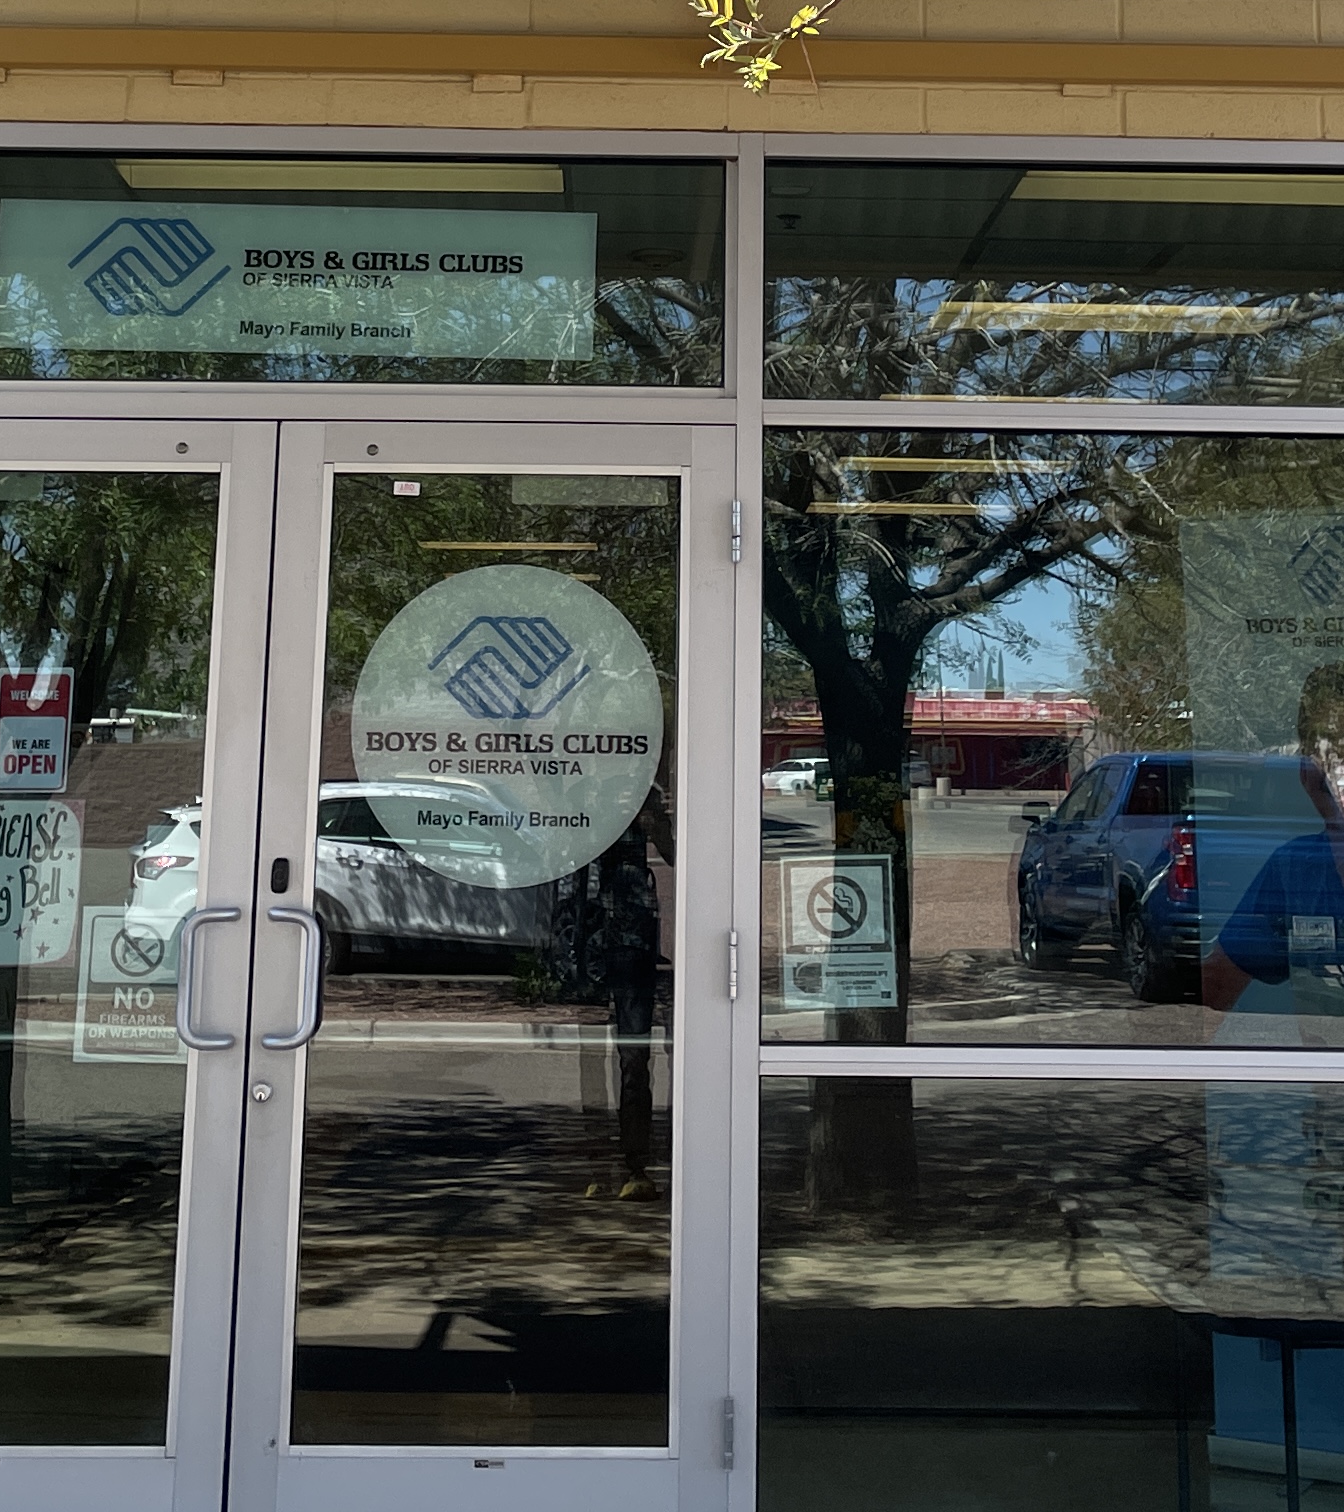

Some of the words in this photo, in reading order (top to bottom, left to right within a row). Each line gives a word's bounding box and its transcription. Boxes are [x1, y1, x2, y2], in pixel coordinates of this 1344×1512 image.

[243, 249, 315, 270] BOYS
[323, 250, 346, 270] &
[352, 252, 430, 272] GIRLS
[438, 254, 524, 274] CLUBS
[242, 272, 266, 287] OF
[272, 273, 338, 289] SIERRA
[343, 274, 394, 290] VISTA
[239, 320, 285, 338] Mayo
[289, 321, 346, 340] Family
[350, 322, 412, 338] Branch
[1245, 617, 1298, 634] BOYS
[1302, 617, 1319, 633] &
[12, 739, 28, 750] WE
[31, 739, 51, 750] ARE
[365, 731, 437, 752] BOYS
[445, 732, 468, 752] &
[475, 733, 554, 754] GIRLS
[563, 734, 649, 755] CLUBS
[3, 754, 57, 775] OPEN
[428, 759, 453, 774] OF
[458, 759, 525, 775] SIERRA
[530, 760, 583, 776] VISTA
[417, 810, 464, 829] Mayo
[468, 810, 524, 830] Family
[529, 811, 591, 828] Branch
[19, 864, 61, 909] Bell
[113, 986, 155, 1010] NO
[99, 1014, 166, 1026] FIREARMS
[88, 1028, 107, 1039] OR
[109, 1028, 175, 1039] WEAPONS
